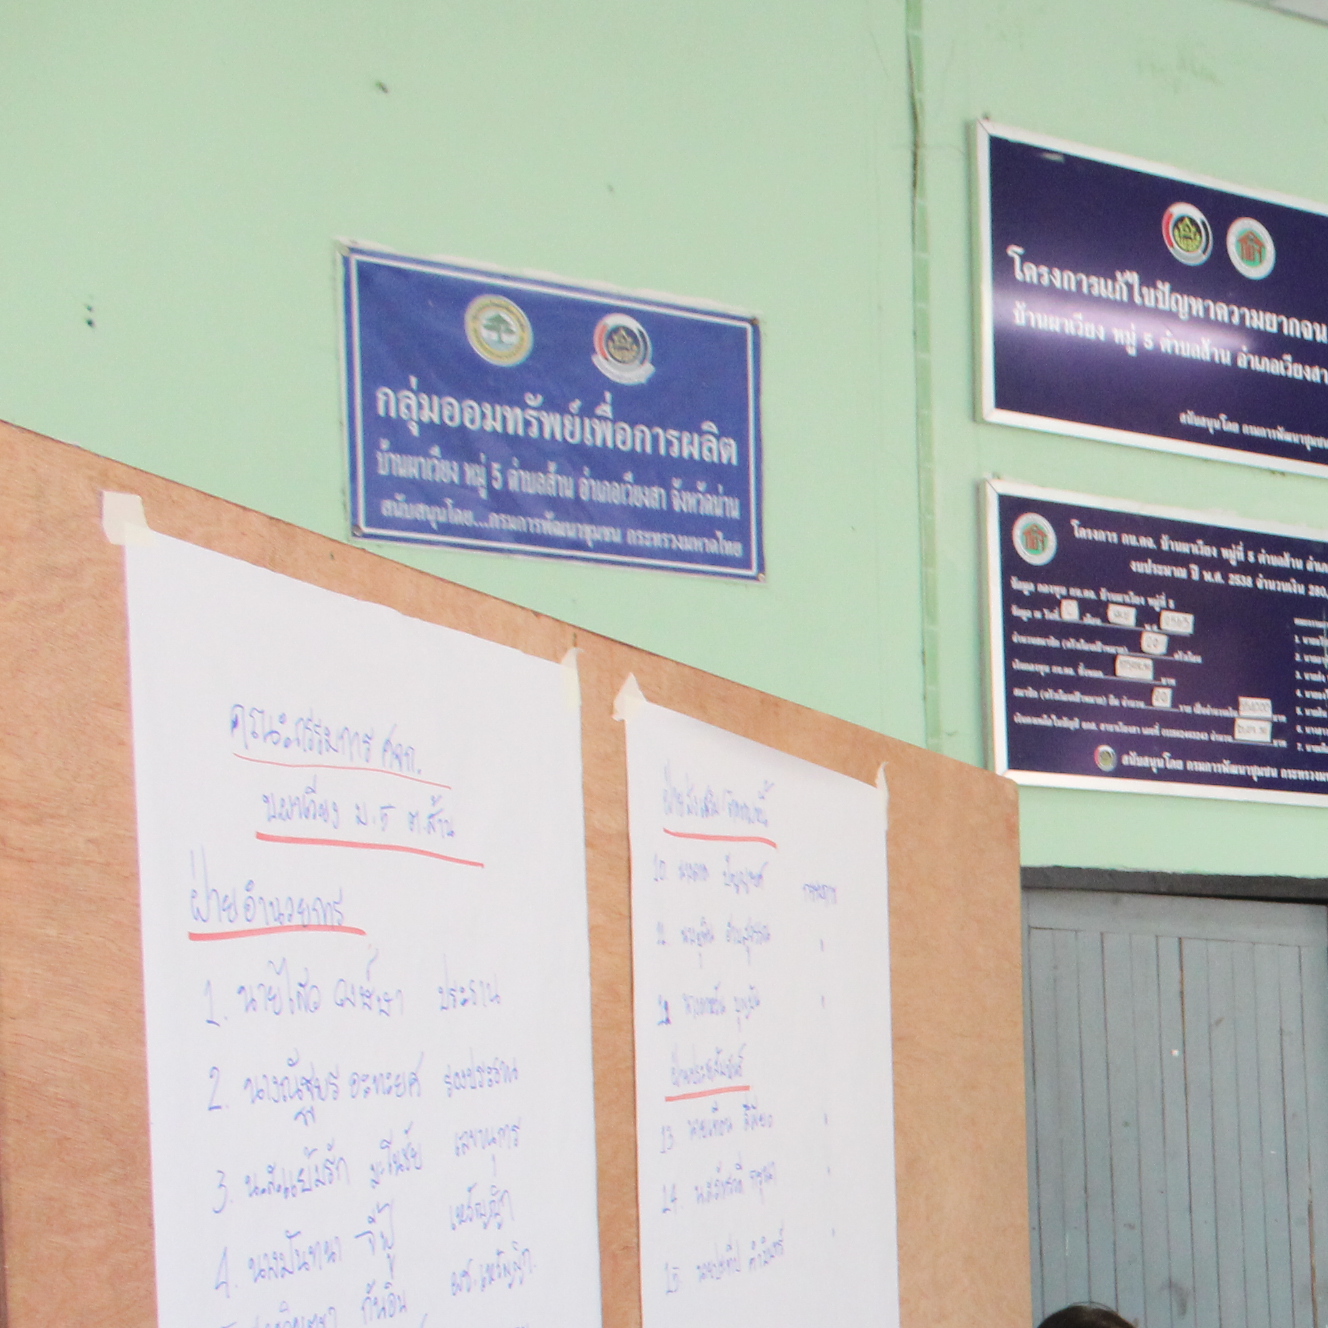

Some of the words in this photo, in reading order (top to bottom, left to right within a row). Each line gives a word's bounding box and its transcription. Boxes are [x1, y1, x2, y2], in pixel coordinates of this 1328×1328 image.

[376, 375, 738, 466] กลุ่มออมทรัพย์เพื่อการผลิต
[376, 439, 458, 484] บ้านผาเวียง
[492, 463, 502, 488] 5
